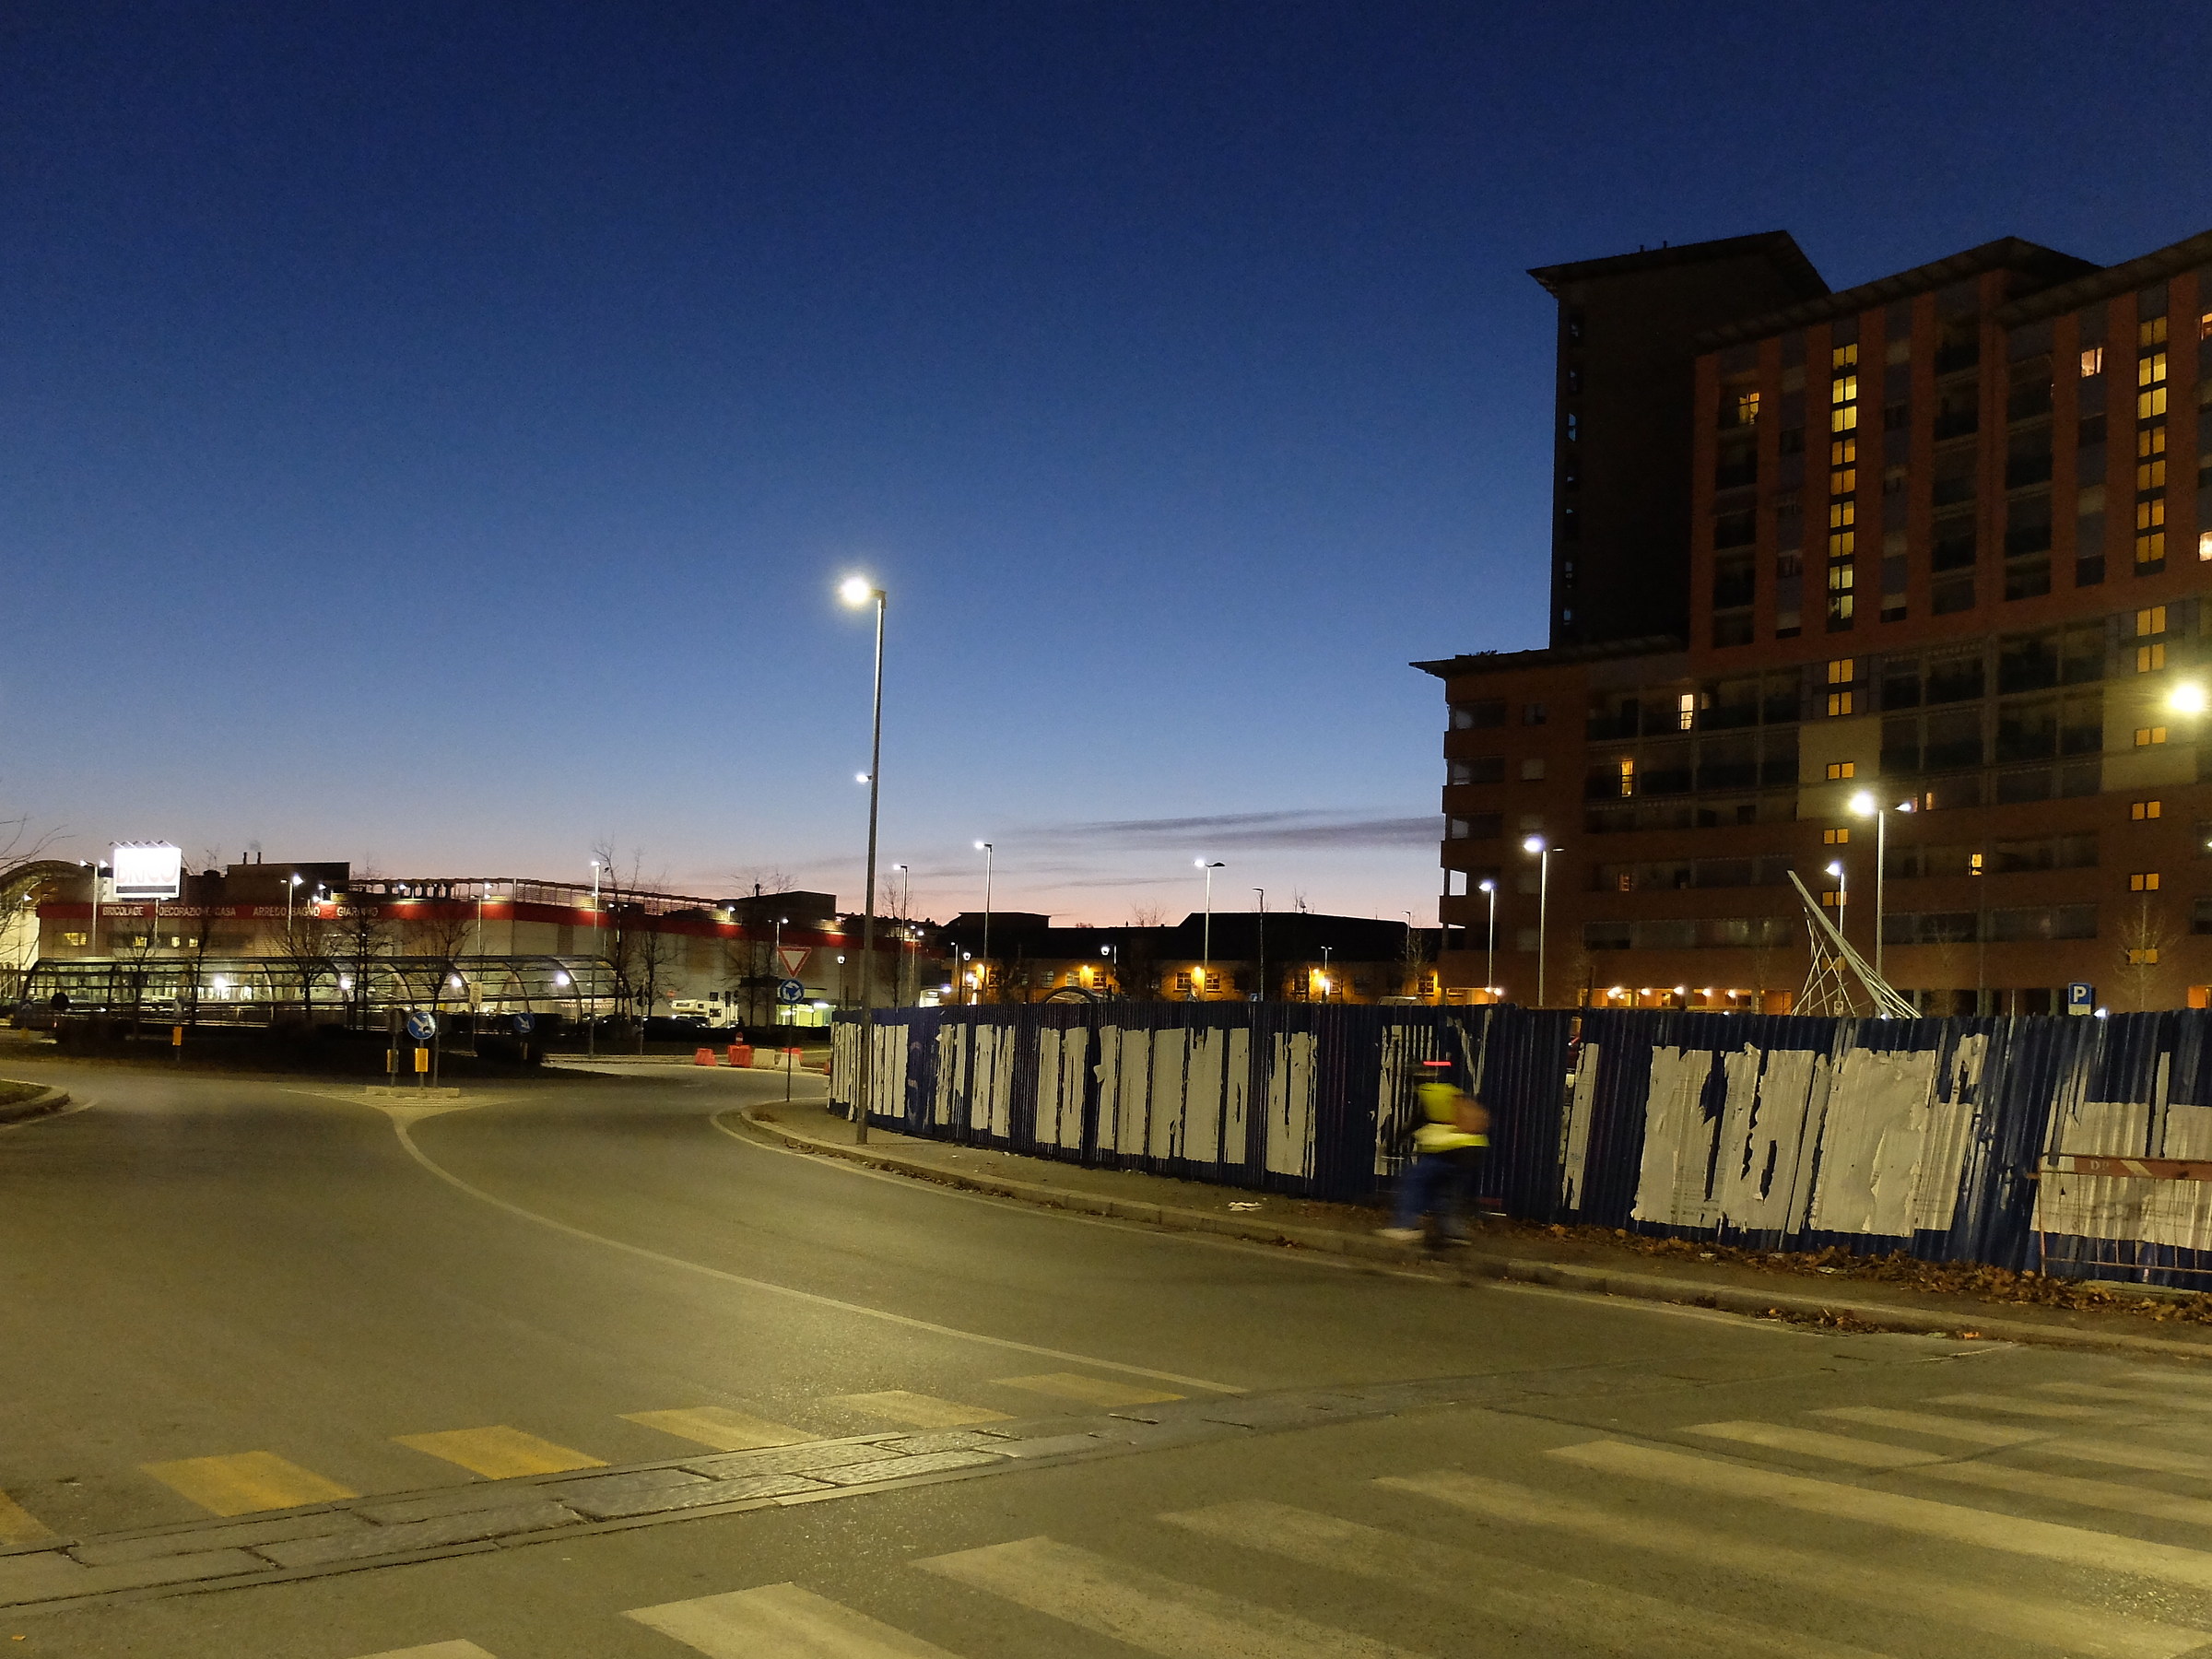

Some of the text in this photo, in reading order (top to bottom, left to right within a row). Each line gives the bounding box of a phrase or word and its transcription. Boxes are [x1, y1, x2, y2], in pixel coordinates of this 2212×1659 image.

[102, 906, 144, 916] BRICOLAGE
[159, 906, 211, 917] DECORAZIOE
[336, 906, 379, 917] GIARO
[2073, 985, 2088, 1003] P
